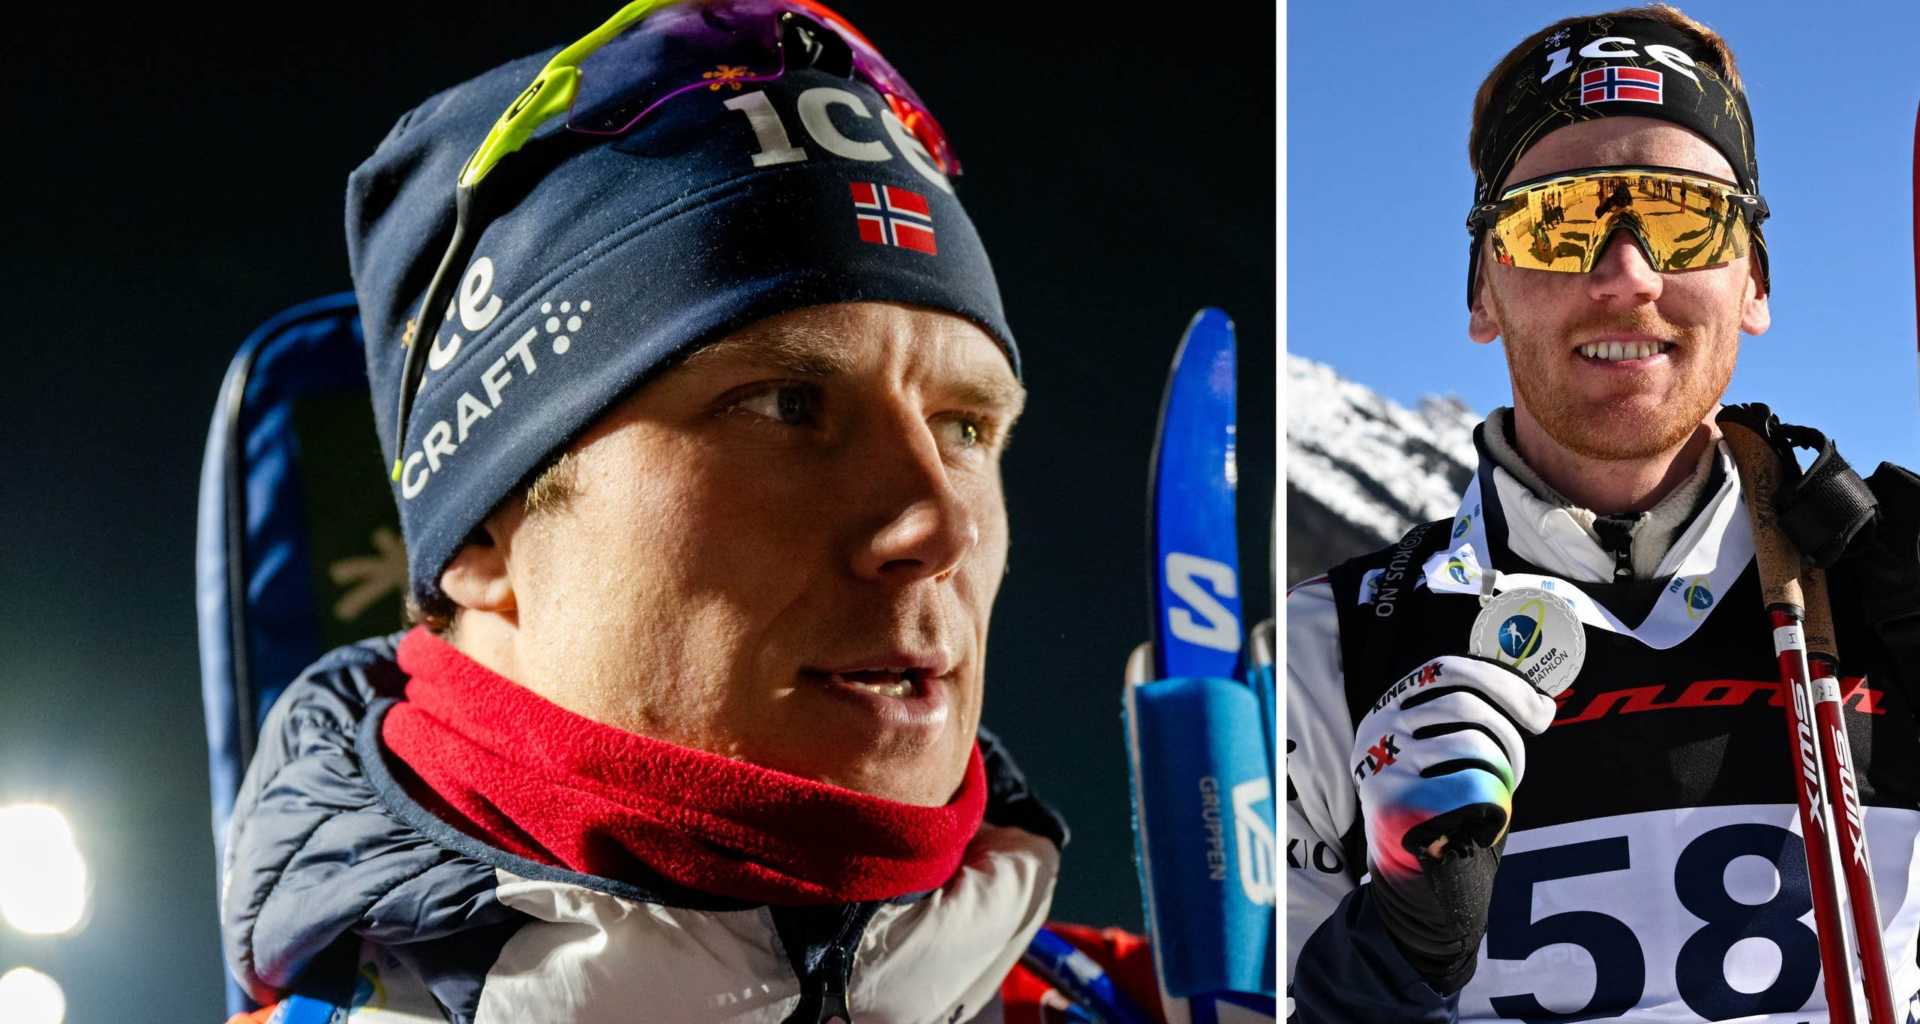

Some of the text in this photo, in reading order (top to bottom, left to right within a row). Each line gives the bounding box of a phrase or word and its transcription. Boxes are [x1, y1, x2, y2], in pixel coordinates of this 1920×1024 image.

[1541, 36, 1700, 84] ice
[722, 86, 954, 195] ice
[416, 256, 503, 396] ce
[400, 325, 539, 500] CRAFT
[1669, 576, 1686, 594] IBU
[1372, 661, 1444, 715] KINETIXX
[1525, 647, 1558, 678] IBU CUP
[1354, 733, 1401, 788] TIXX
[1790, 677, 1825, 834] SWIX
[1831, 724, 1868, 877] SWIX
[1198, 775, 1228, 882] GRUPPEN
[1486, 823, 1823, 1024] 58
